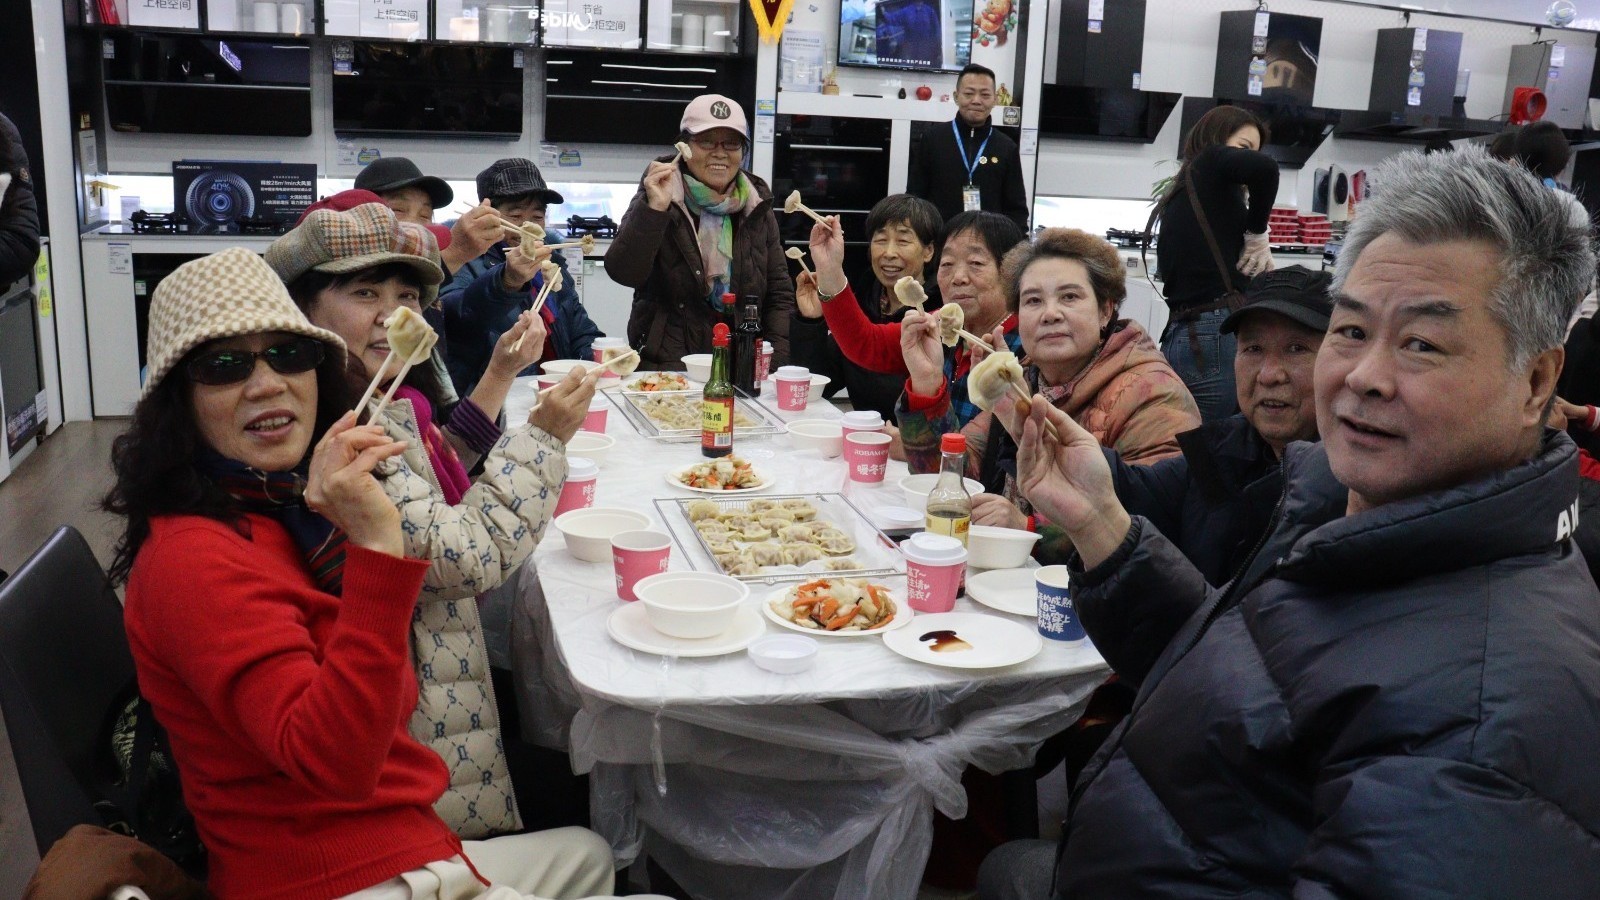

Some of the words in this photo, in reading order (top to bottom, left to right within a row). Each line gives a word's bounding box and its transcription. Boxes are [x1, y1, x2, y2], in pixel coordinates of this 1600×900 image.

[143, 0, 191, 10] 上柜空间
[583, 4, 602, 15] 节省
[713, 102, 728, 117] NY
[211, 182, 231, 191] 40%
